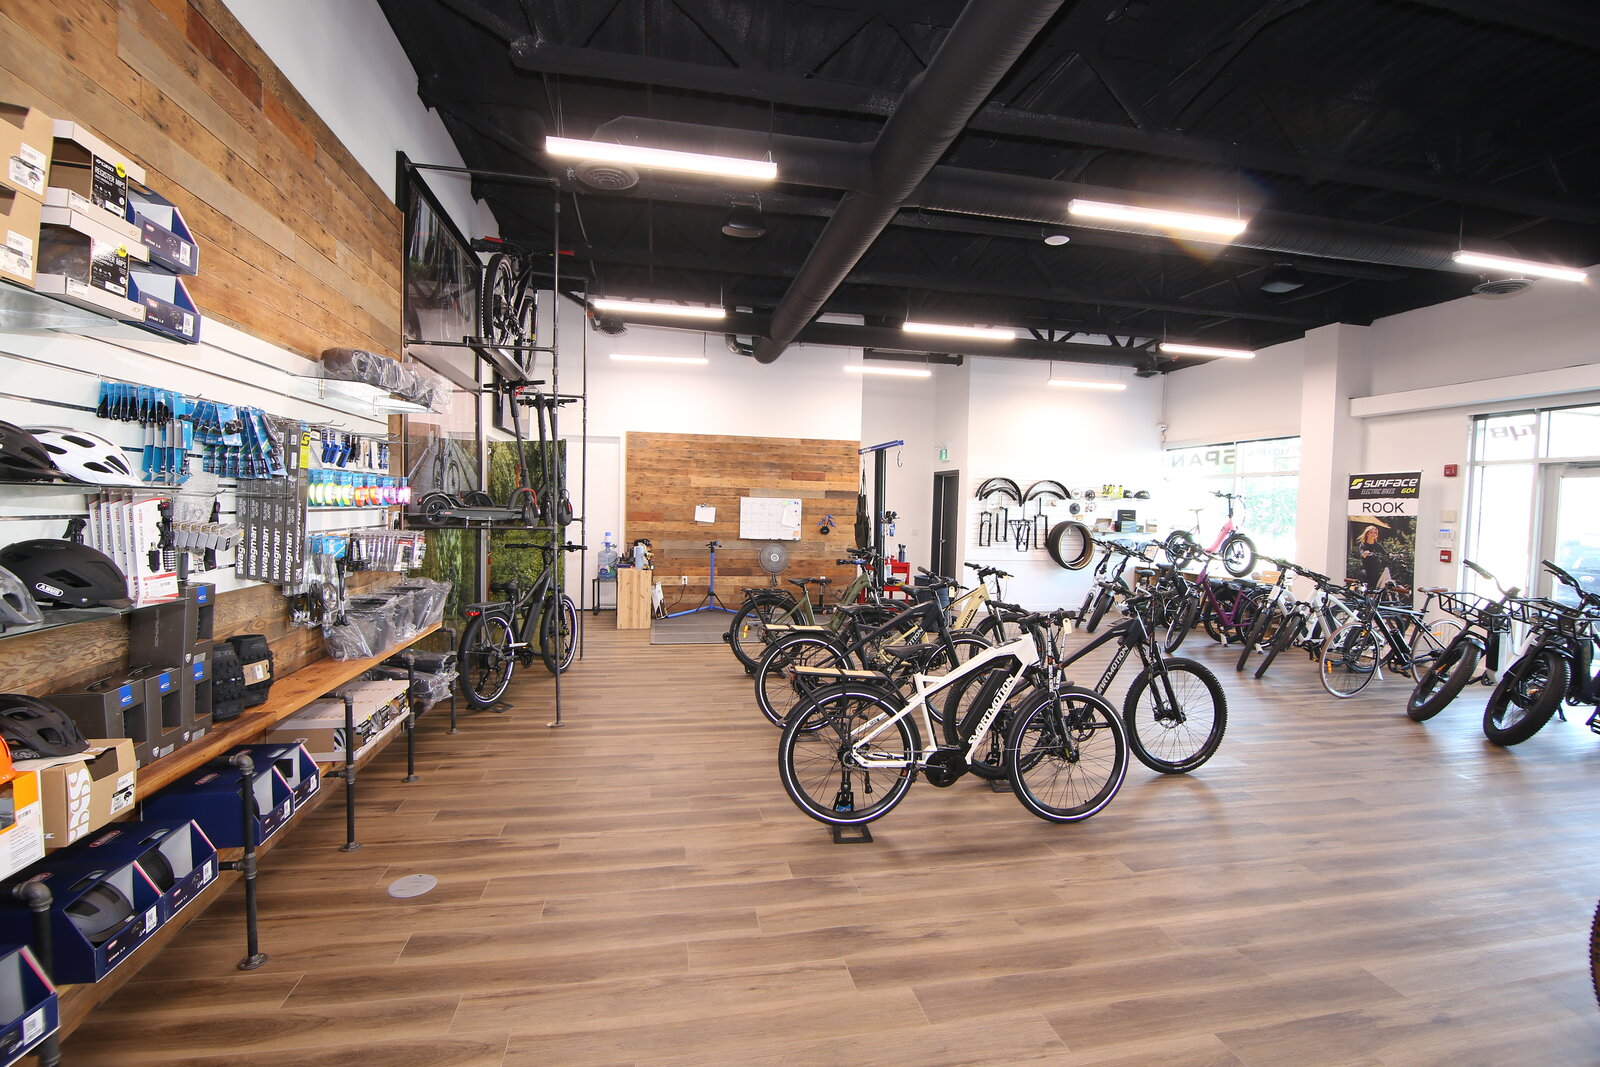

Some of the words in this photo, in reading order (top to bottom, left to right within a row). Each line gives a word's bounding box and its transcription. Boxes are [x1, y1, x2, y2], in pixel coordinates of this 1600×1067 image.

[1362, 502, 1405, 513] ROOK
[250, 526, 258, 576] swagman
[262, 528, 270, 578] swagman
[273, 531, 281, 580] swagman
[284, 533, 293, 582] swagman
[38, 583, 61, 595] ABUS
[967, 673, 1016, 745] SMARTMOTION
